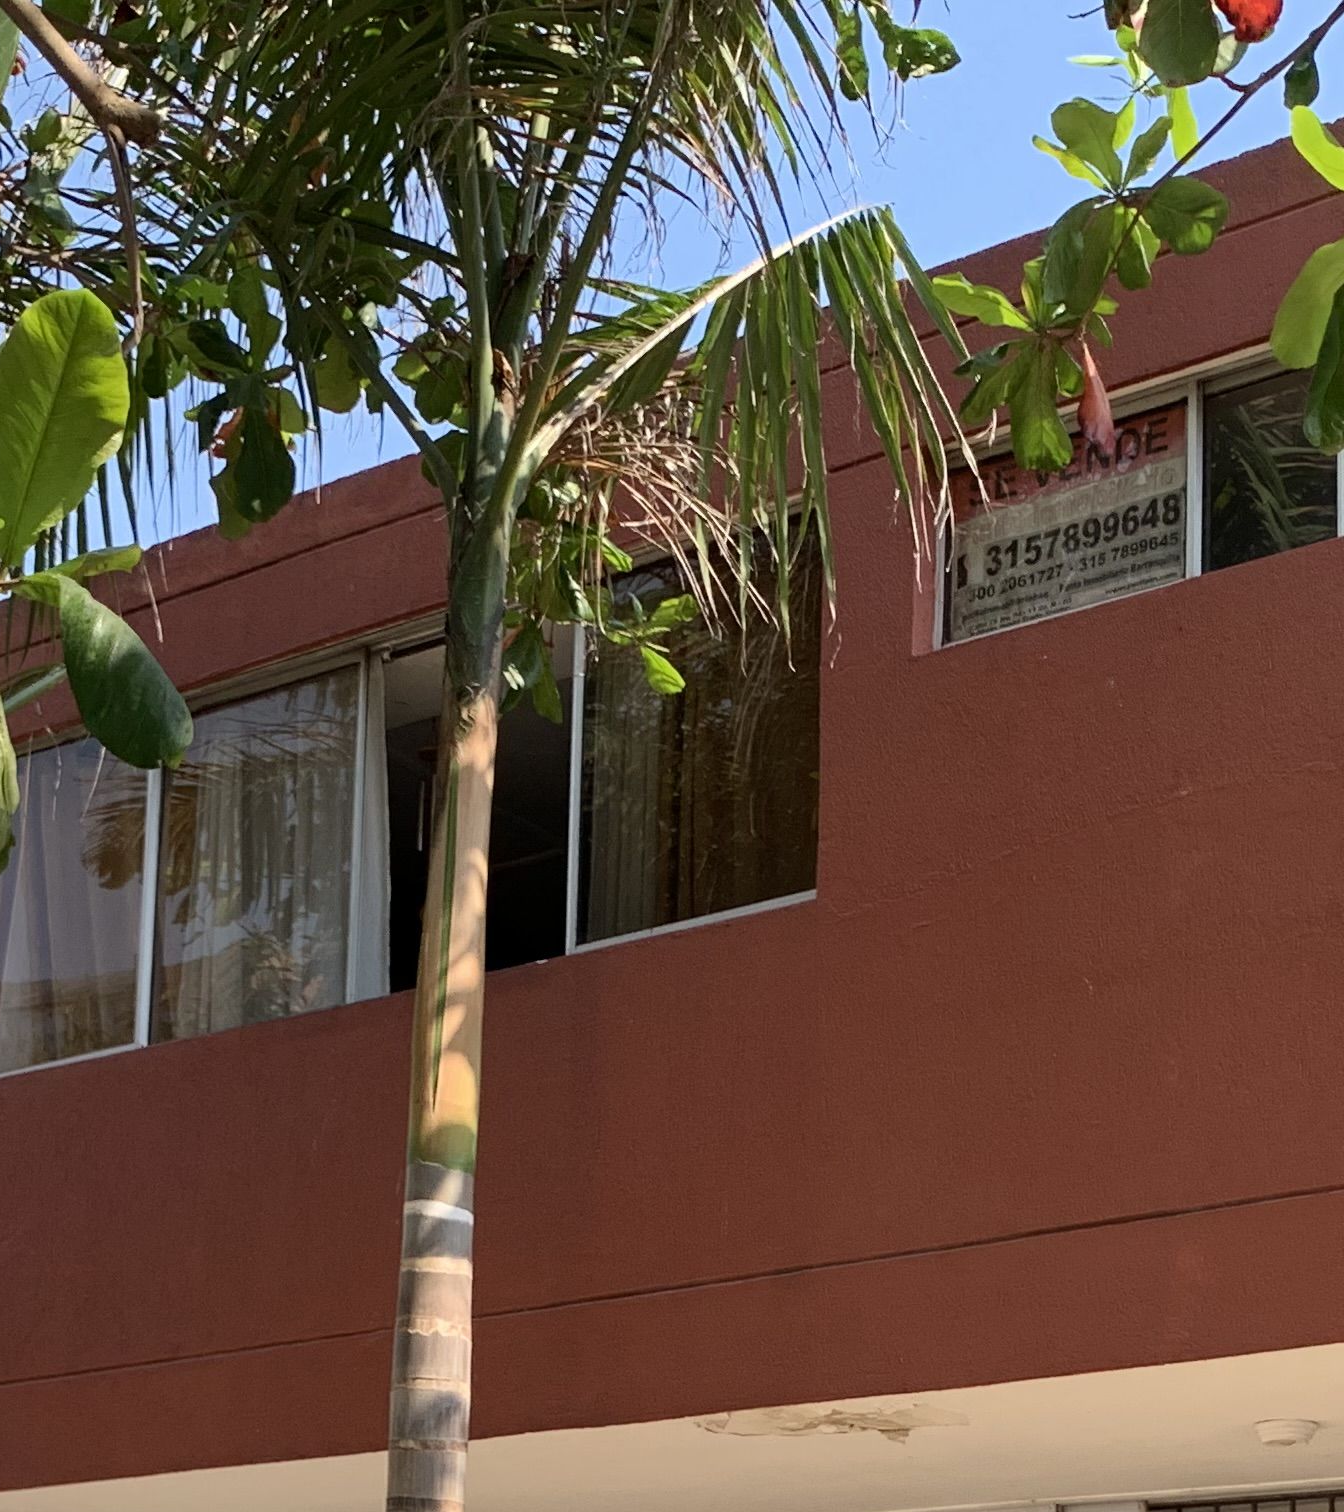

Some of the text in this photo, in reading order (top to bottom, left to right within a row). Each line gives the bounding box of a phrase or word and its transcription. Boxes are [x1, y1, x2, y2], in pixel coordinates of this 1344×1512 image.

[986, 494, 1181, 577] 3157899648
[1079, 552, 1105, 571] 315
[1110, 532, 1179, 561] 7899645
